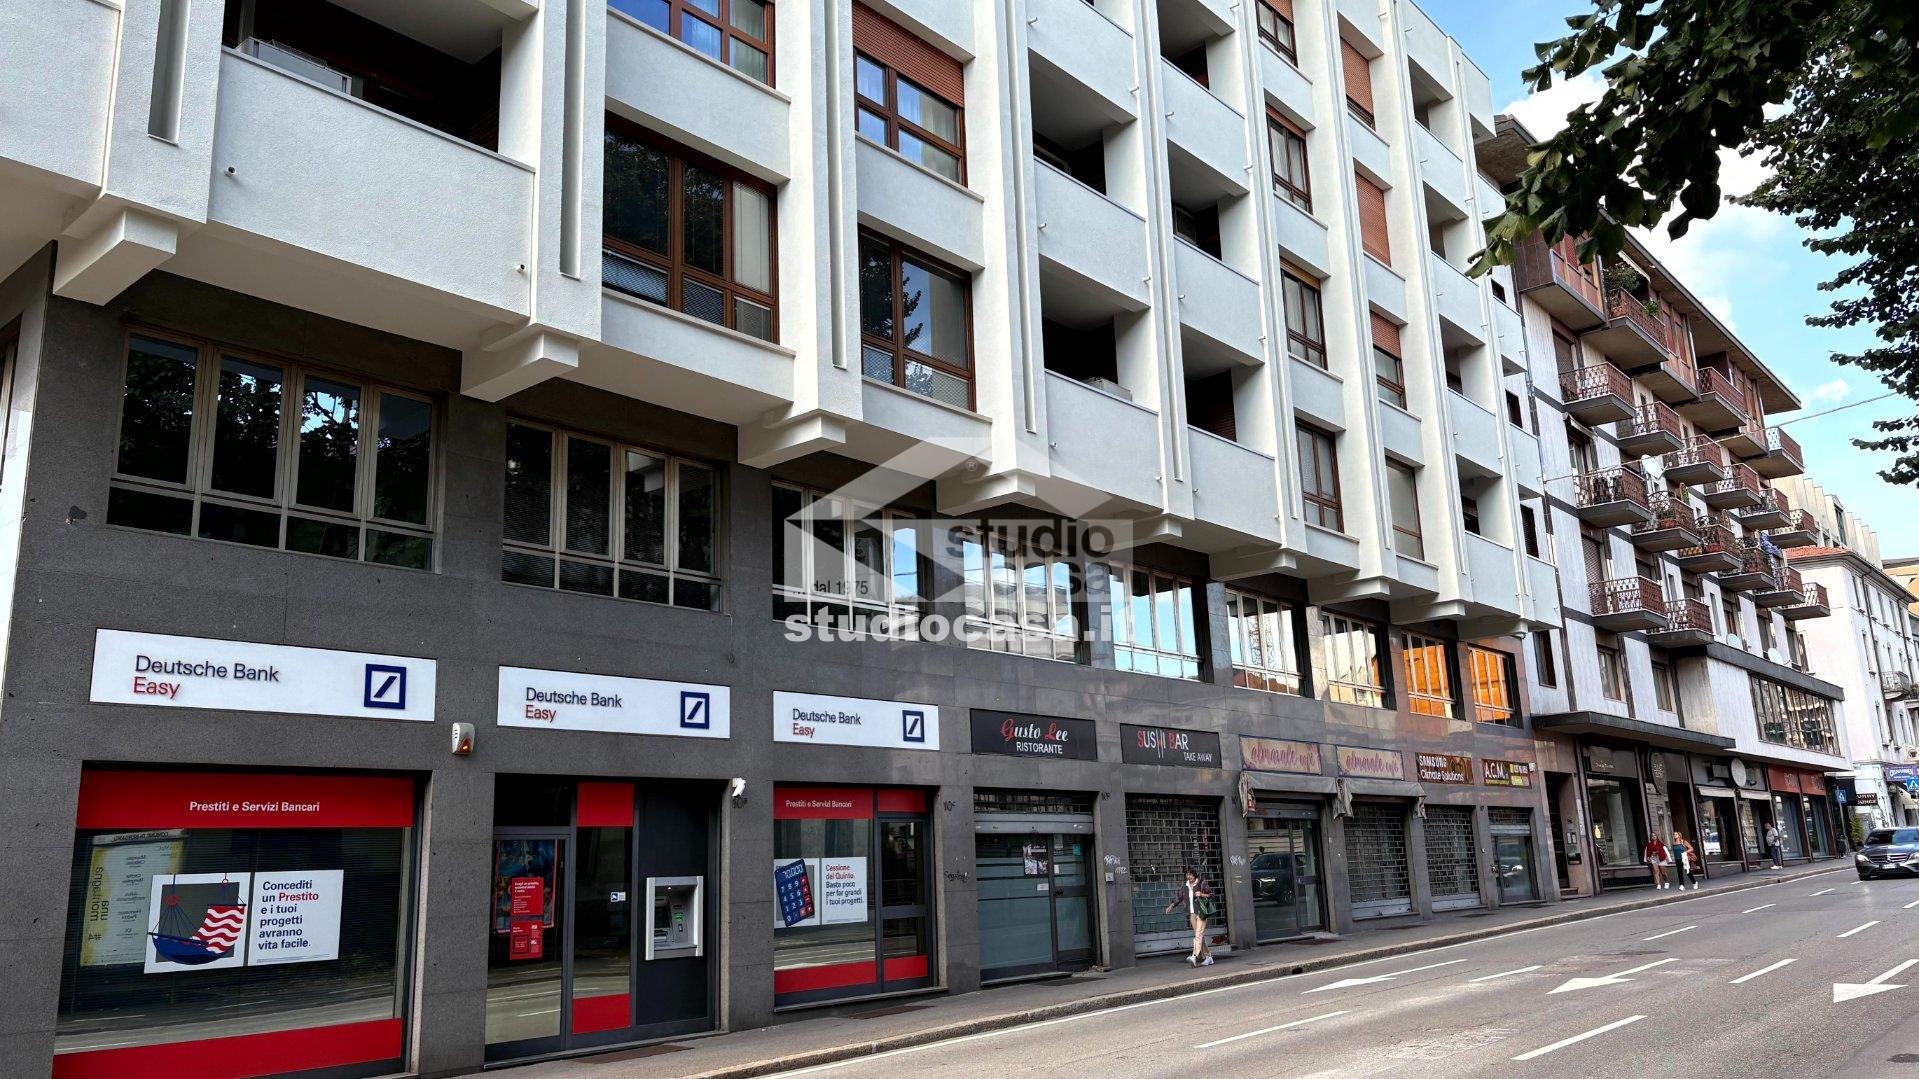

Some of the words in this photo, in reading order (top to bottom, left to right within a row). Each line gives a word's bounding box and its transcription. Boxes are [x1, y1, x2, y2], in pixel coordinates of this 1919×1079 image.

[135, 655, 227, 678] Deutsche
[233, 663, 279, 682] Bank
[133, 676, 181, 699] Easy
[526, 687, 587, 705] Deutsche
[591, 692, 622, 708] Bank
[525, 704, 557, 723] Easy
[792, 708, 837, 723] Deutsche
[838, 712, 861, 725] Bank
[792, 723, 815, 738] Easy
[1001, 717, 1040, 741] Gusto
[1045, 722, 1068, 741] Lee
[1168, 731, 1189, 750] BAR
[1016, 742, 1063, 754] RISTORANTE
[1183, 751, 1197, 761] TAKE
[1197, 752, 1213, 763] AWAY
[1419, 755, 1447, 768] SAMSUNG
[1421, 769, 1441, 780] Climate
[1441, 770, 1464, 782] Solutions
[189, 801, 230, 812] Prestiti
[232, 802, 239, 812] e
[241, 801, 279, 812] Servizi
[281, 801, 321, 812] Bancari
[785, 799, 807, 808] Prestiti
[812, 800, 831, 808] Servizi
[831, 800, 853, 808] Bancari
[825, 864, 850, 872] Cessione
[262, 879, 313, 891] Concediti
[262, 894, 276, 903] un
[278, 891, 319, 902] Prestito
[845, 888, 862, 897] grandi
[261, 906, 268, 915] e
[270, 904, 274, 914] i
[276, 903, 297, 914] tuoi
[259, 914, 303, 928] progetti
[259, 928, 303, 939] avranno
[258, 940, 278, 950] vita
[280, 938, 311, 949] facile.
